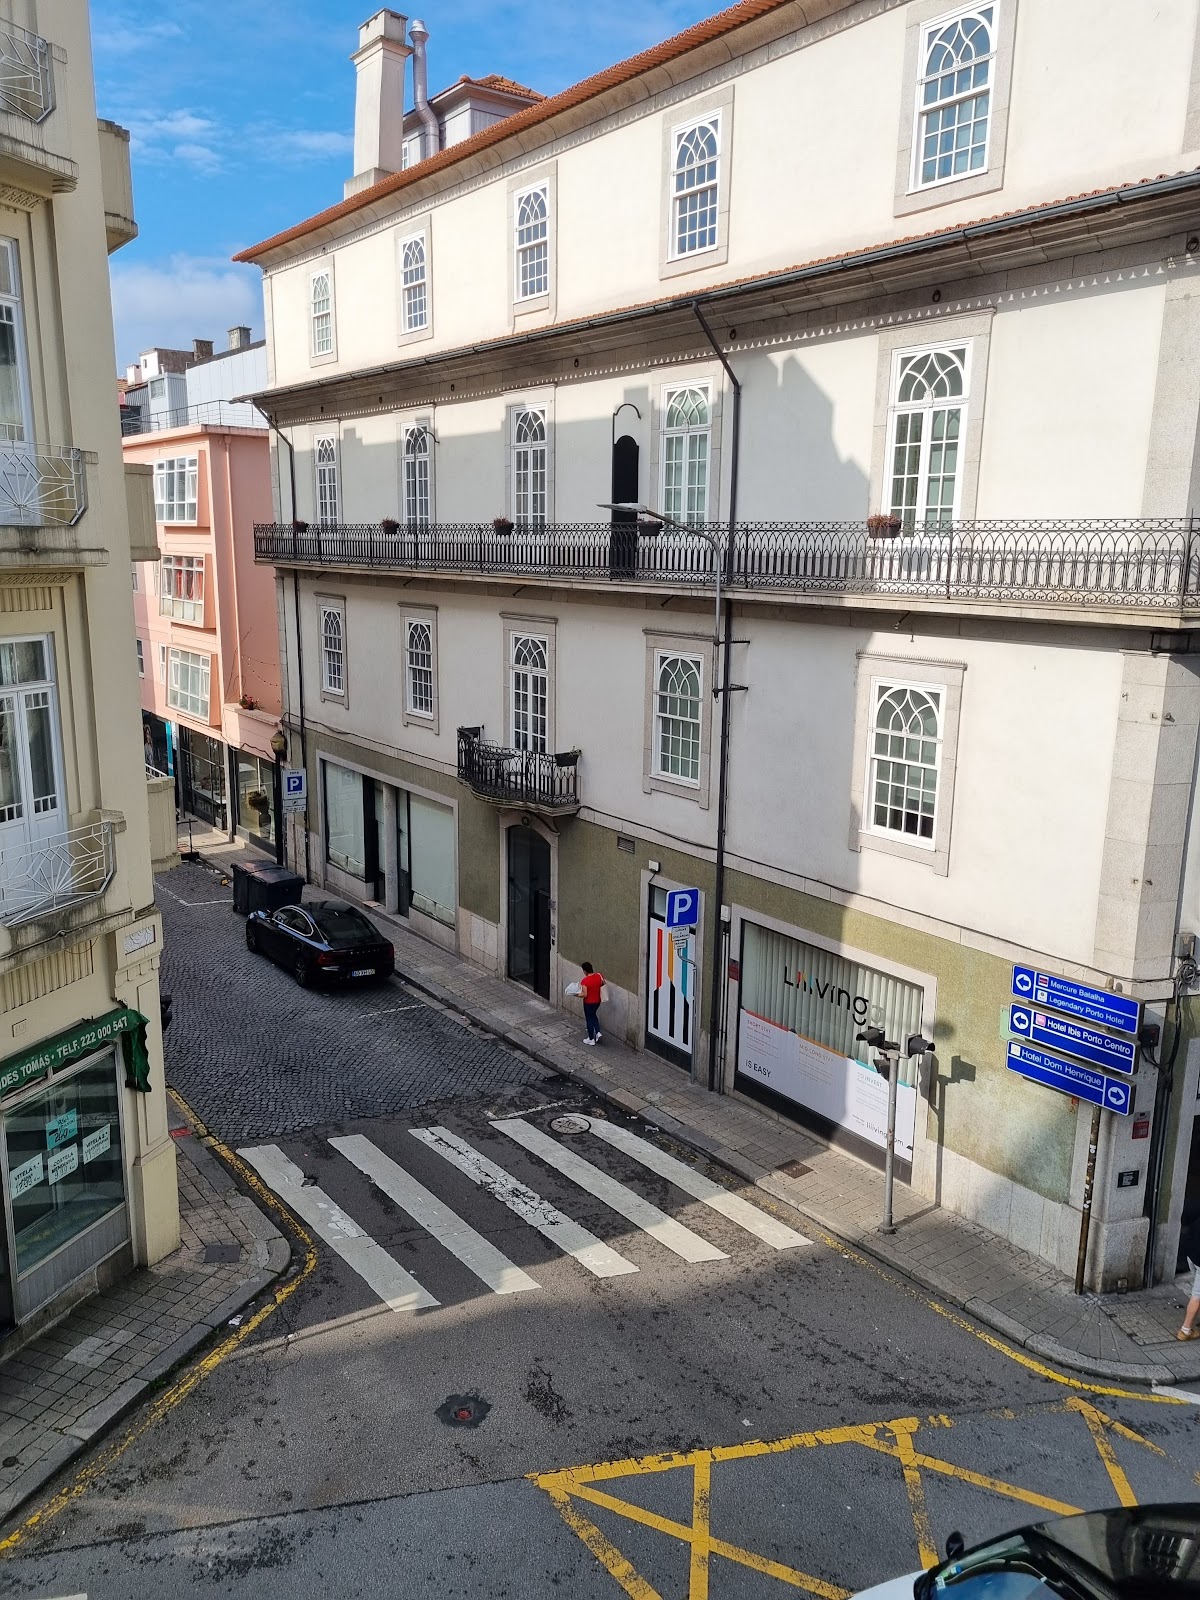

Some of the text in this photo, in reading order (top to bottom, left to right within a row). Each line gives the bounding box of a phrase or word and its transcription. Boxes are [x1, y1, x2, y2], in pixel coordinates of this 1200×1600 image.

[290, 778, 299, 790] P
[673, 894, 692, 923] P
[1050, 980, 1105, 1003] Mercure Batalha
[1049, 995, 1124, 1025] Legendary Porto Hotel
[20, 1053, 50, 1077] TOMÁS
[81, 1032, 97, 1047] 222
[97, 1024, 111, 1039] 000
[113, 1016, 128, 1031] 547
[1047, 1020, 1066, 1033] Hotel
[1068, 1027, 1081, 1038] Ibis
[1083, 1031, 1103, 1045] Porto
[1104, 1039, 1130, 1055] Centro
[745, 1059, 771, 1078] IS EASY
[864, 1075, 883, 1088] INVEST
[1021, 1049, 1102, 1086] Hotel Dom Henrique
